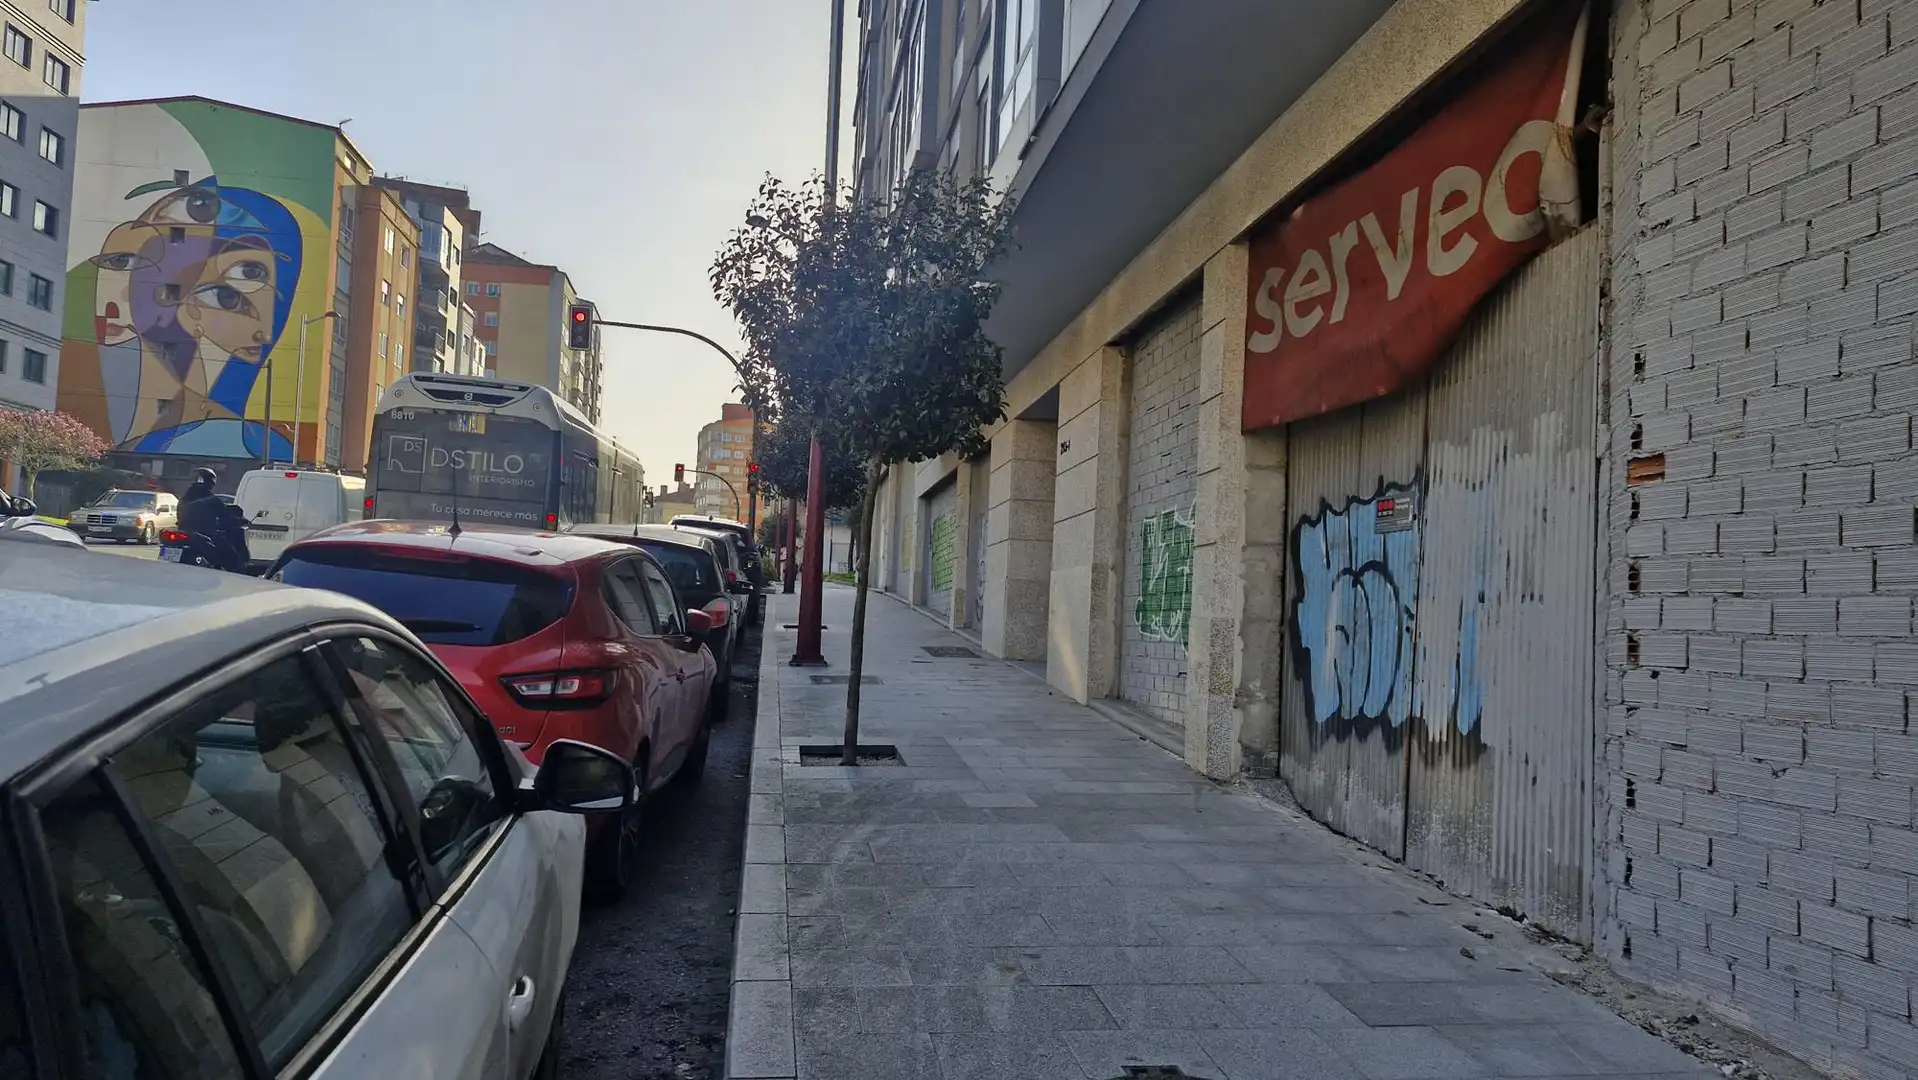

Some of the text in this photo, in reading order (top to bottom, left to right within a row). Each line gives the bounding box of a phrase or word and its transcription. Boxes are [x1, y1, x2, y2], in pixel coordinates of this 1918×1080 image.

[391, 410, 415, 421] 6810
[404, 441, 422, 453] DS
[430, 448, 524, 474] DSTILO
[431, 503, 443, 513] Tu
[473, 508, 513, 520] merece
